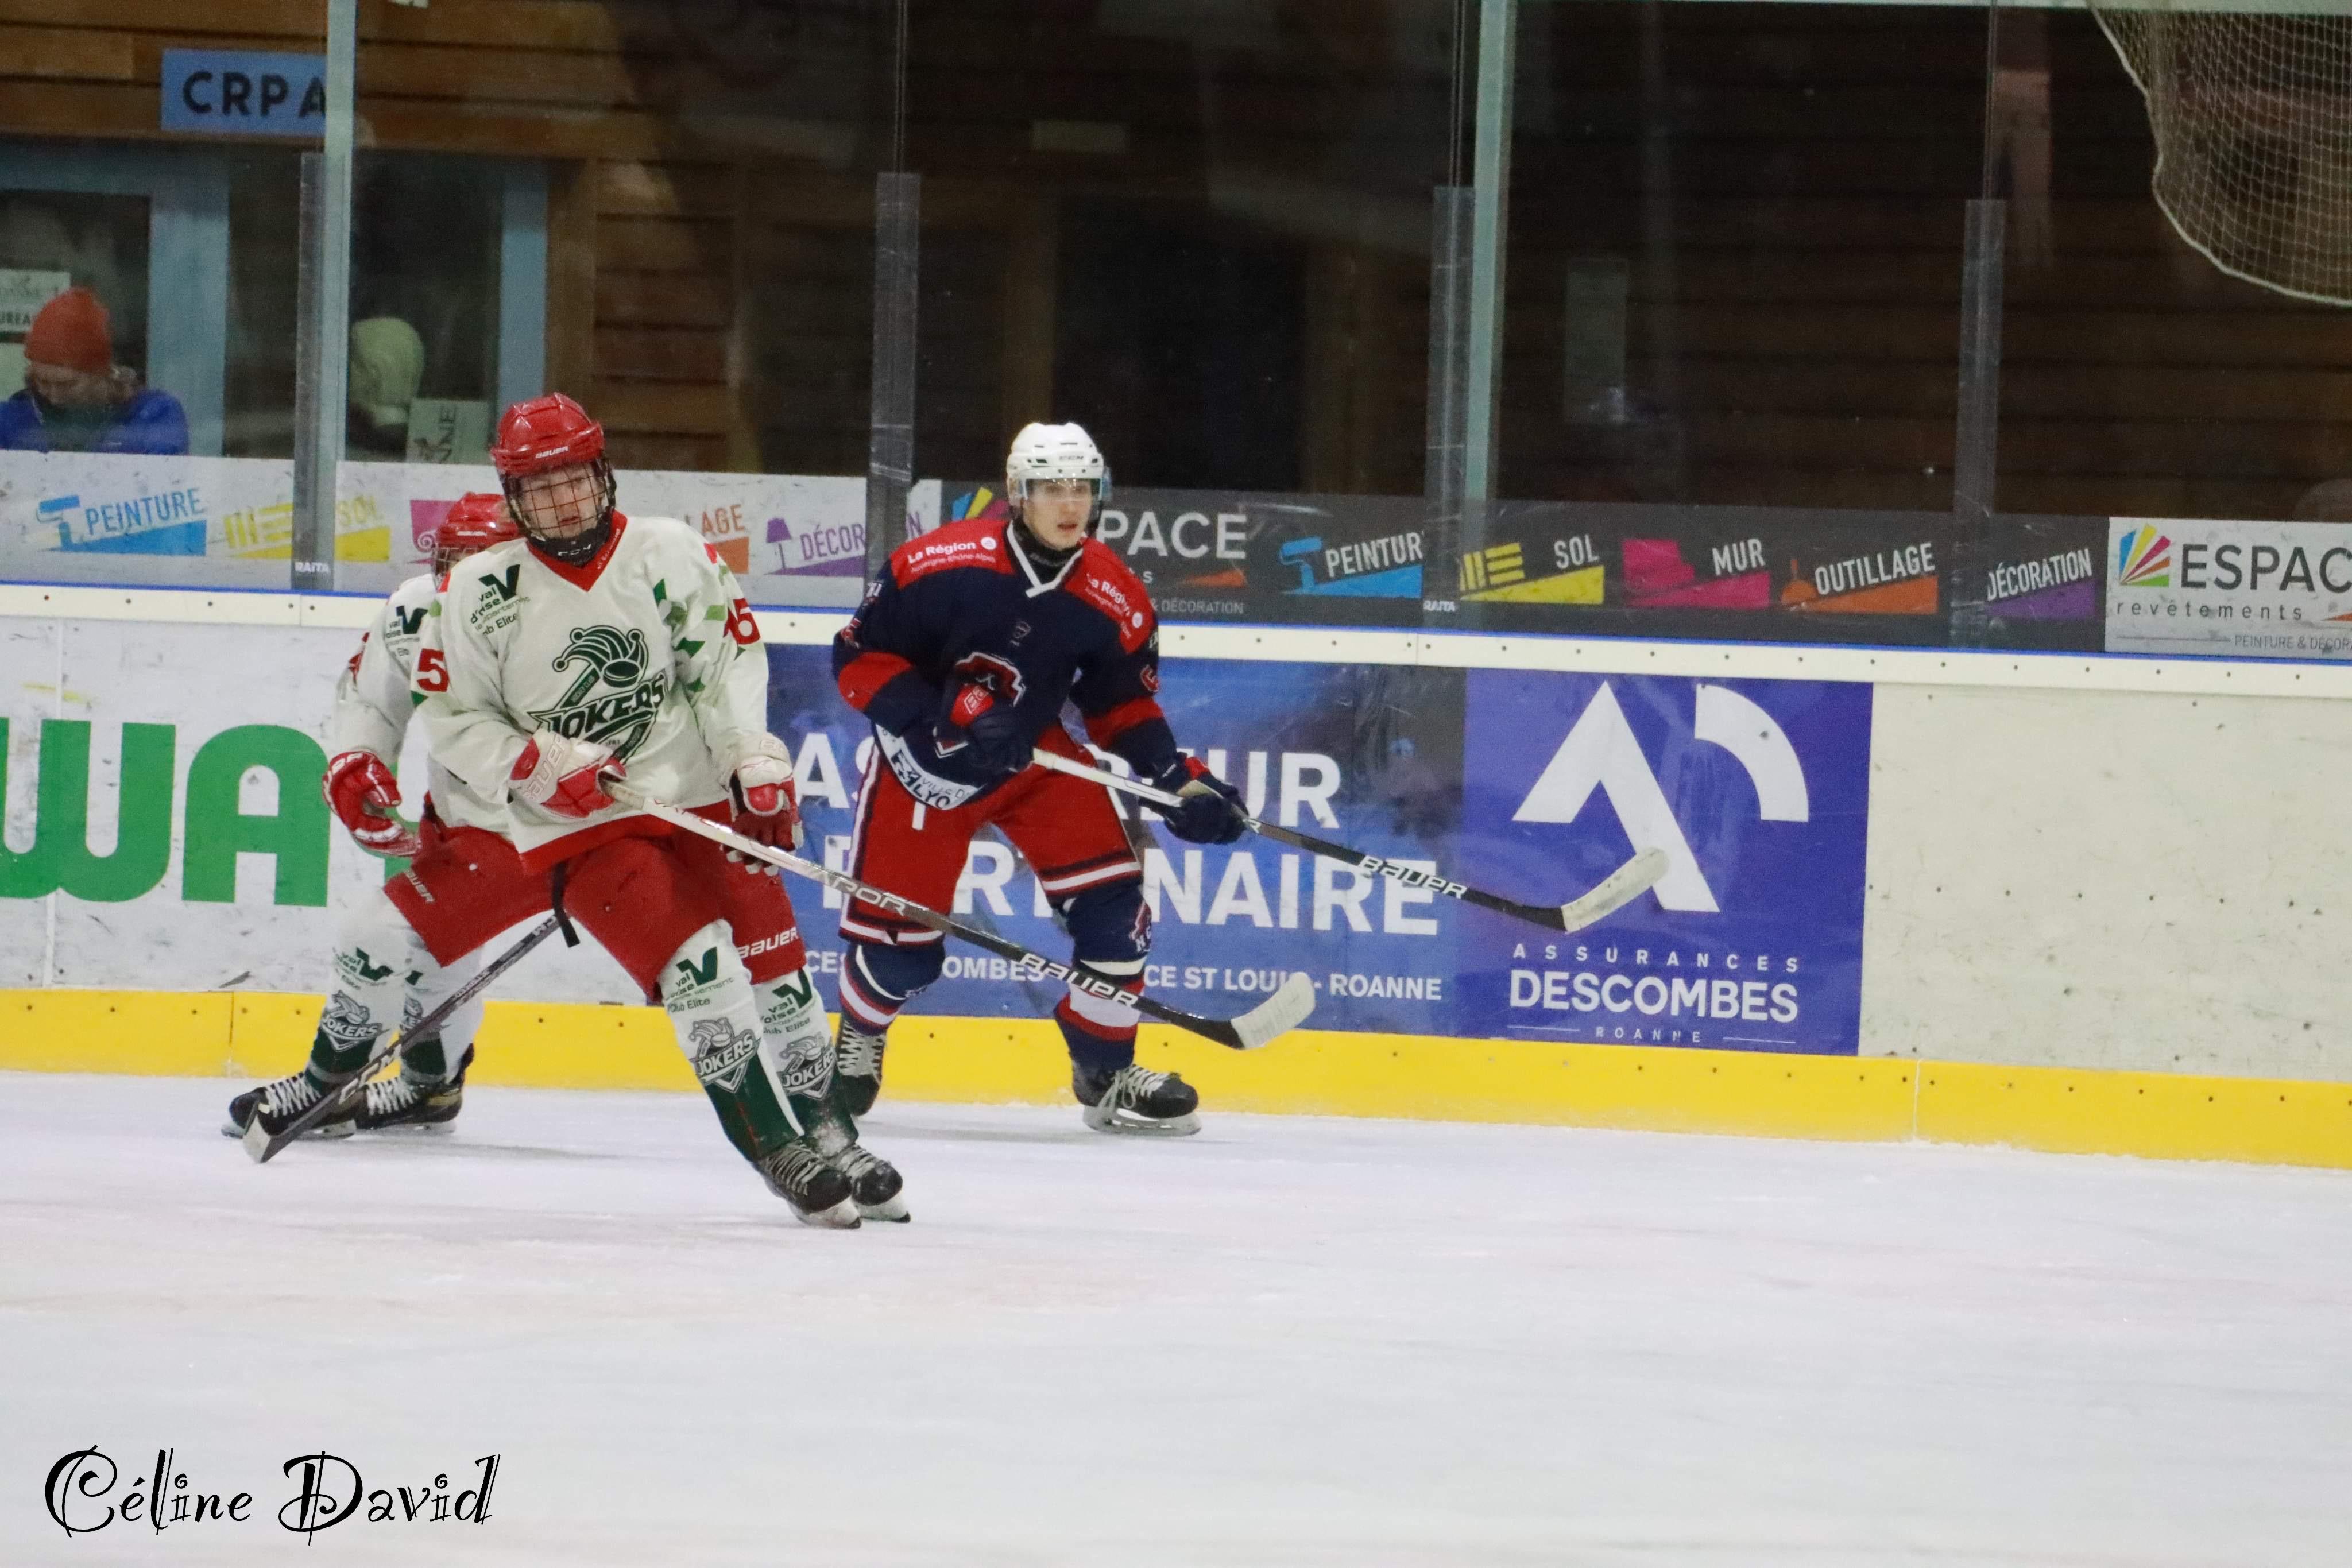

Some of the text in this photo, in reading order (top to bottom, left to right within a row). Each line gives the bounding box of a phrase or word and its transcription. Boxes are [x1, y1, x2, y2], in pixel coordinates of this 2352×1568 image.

[86, 488, 206, 535] PEINTURE
[907, 541, 977, 564] La Région
[1096, 510, 1247, 559] PACE
[1326, 531, 1425, 578] PEINTUR
[1554, 535, 1599, 569] SOL
[1712, 539, 1766, 575] MUR
[1814, 543, 1935, 595] OUTILLAGE
[1987, 549, 2092, 601] DÉCORATION
[2181, 544, 2352, 593] ESPAC
[479, 587, 497, 602] val
[2235, 635, 2293, 649] PEINTURE
[2297, 637, 2307, 649] &
[550, 673, 666, 740] JOKERS
[0, 717, 419, 907] WA
[912, 784, 951, 810] LYO
[1356, 855, 1469, 899] BAUER
[1513, 943, 1798, 973] ASSURANCES
[675, 973, 691, 988] val
[1019, 953, 1139, 1008] BAUER
[1183, 967, 1218, 989] ST
[1225, 968, 1289, 992] LOUI
[1330, 973, 1442, 1000] ROANNE
[1510, 969, 1798, 1023] DESCOMBES
[768, 997, 793, 1013] val
[697, 1033, 756, 1076] JOKERS
[1596, 1026, 1701, 1043] ROANNE
